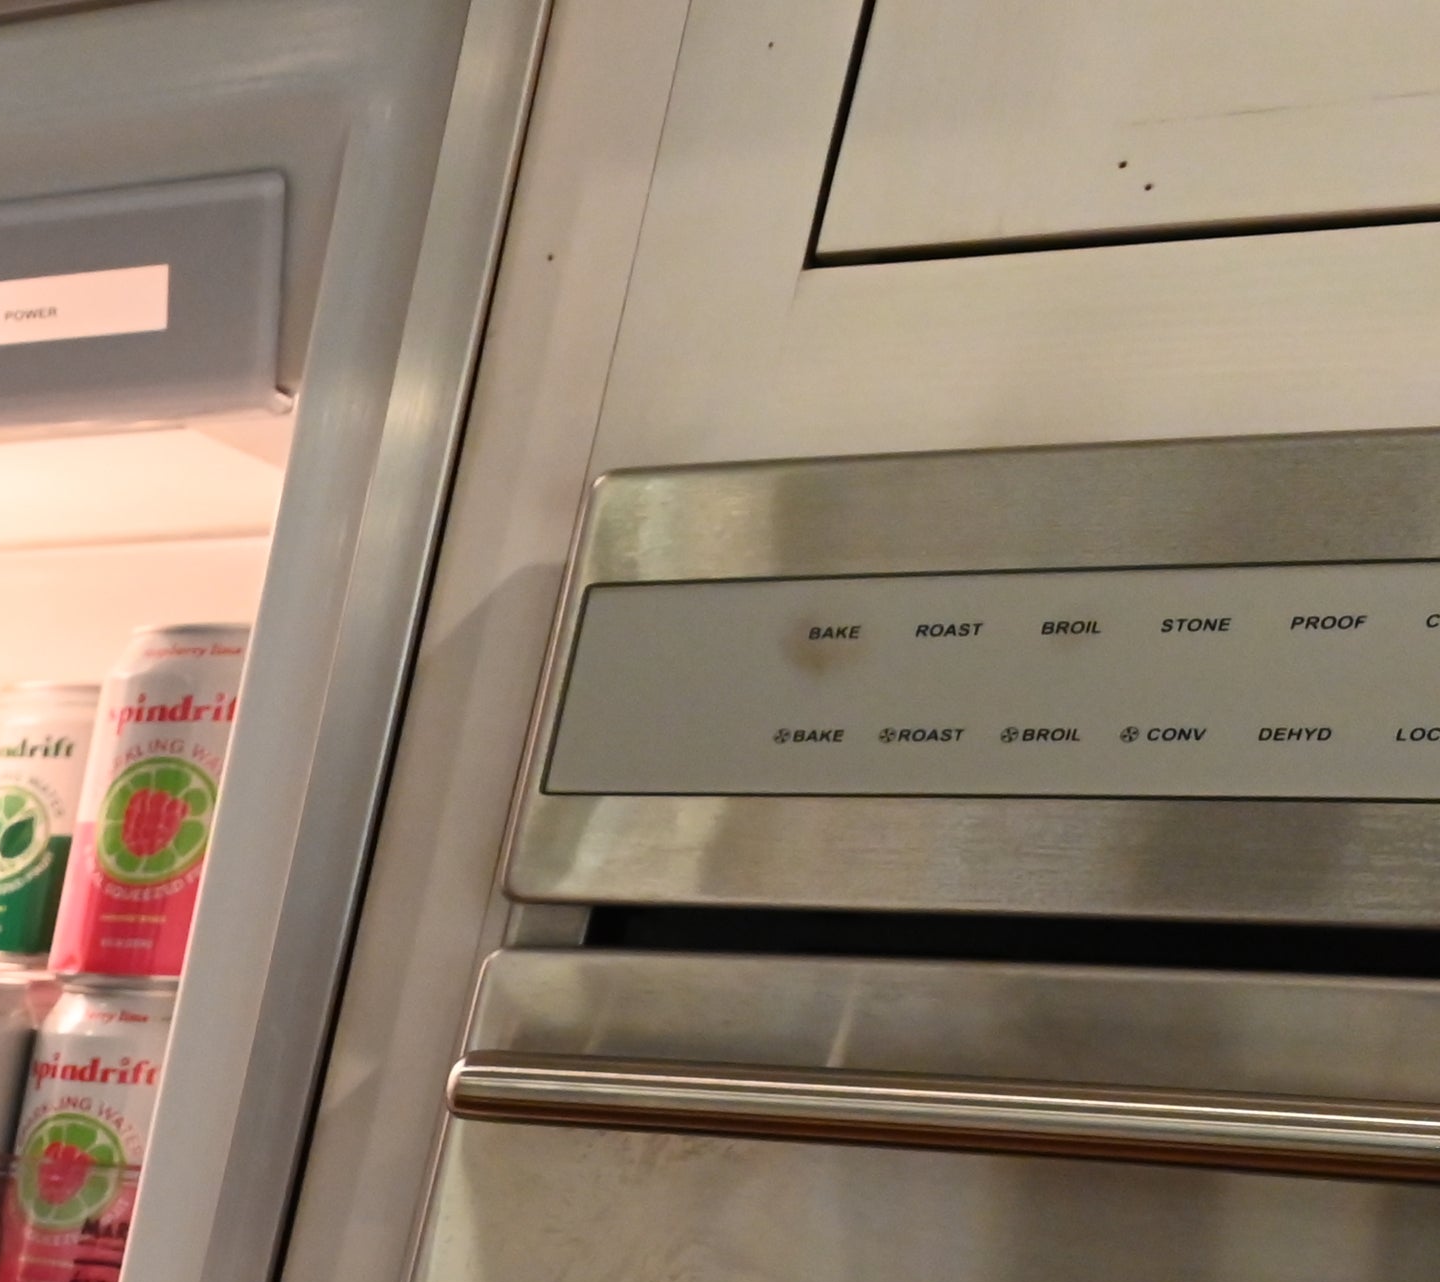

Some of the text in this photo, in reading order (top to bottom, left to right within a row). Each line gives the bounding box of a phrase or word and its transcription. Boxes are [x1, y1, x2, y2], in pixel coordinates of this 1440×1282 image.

[4, 306, 58, 321] POWER
[915, 622, 984, 638] ROAST
[1041, 621, 1101, 635] BROIL
[1161, 617, 1232, 633] STONE
[1290, 615, 1367, 630] PROOF
[808, 625, 861, 640] BAKE
[792, 729, 845, 743] BAKE
[897, 728, 965, 742] ROAST
[1022, 728, 1081, 742] BROIL
[1146, 727, 1207, 742] CONV
[1258, 727, 1332, 742] DEHYD
